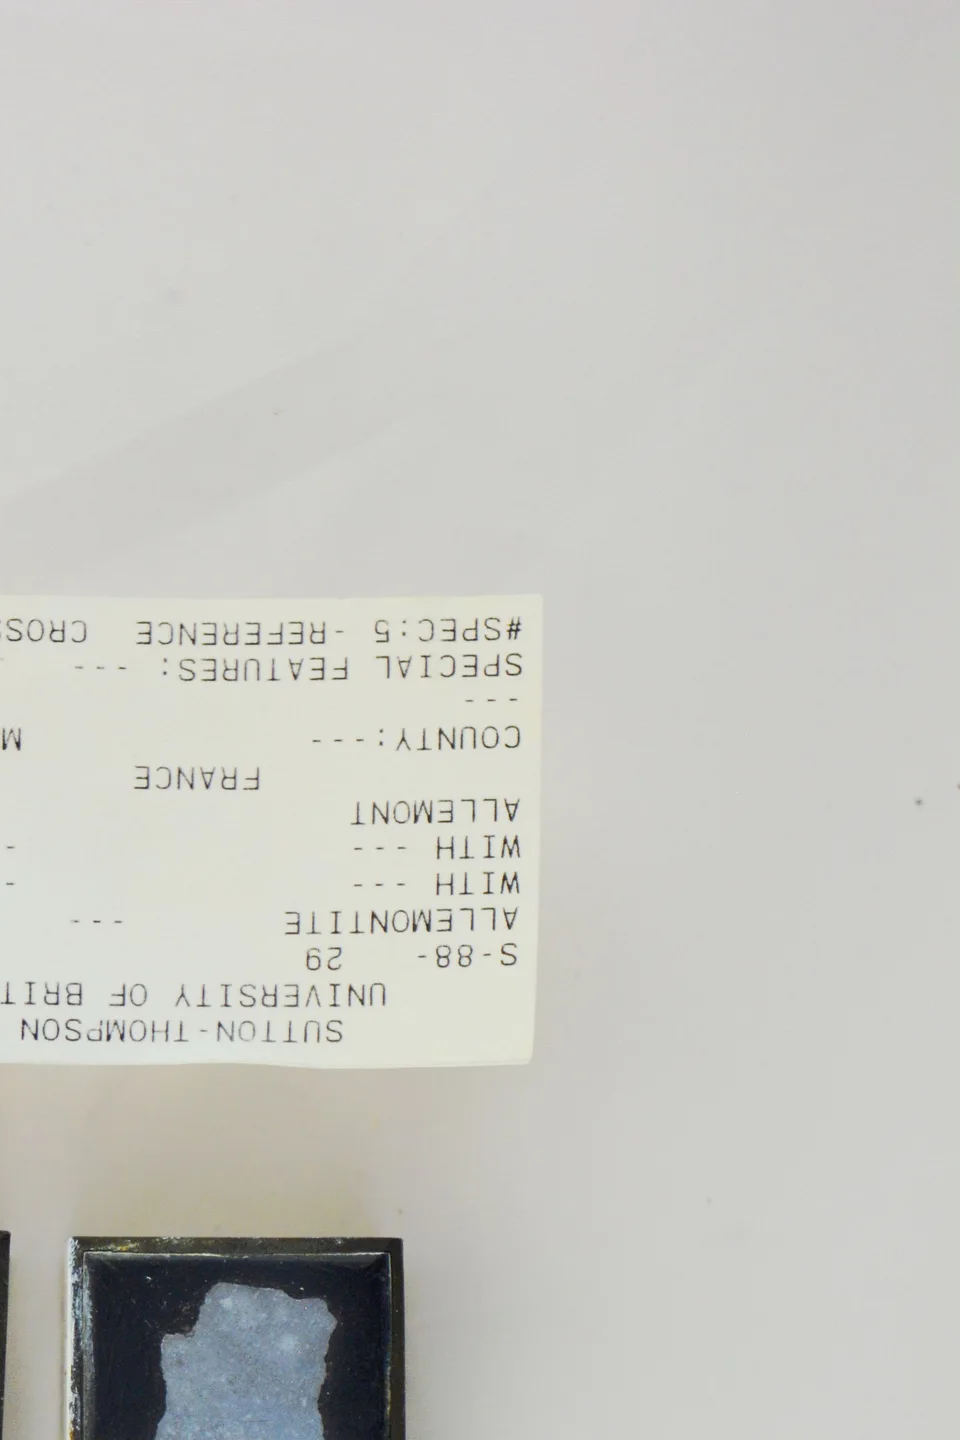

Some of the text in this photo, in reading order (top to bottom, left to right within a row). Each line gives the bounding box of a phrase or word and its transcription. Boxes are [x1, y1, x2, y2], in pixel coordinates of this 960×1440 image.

[162, 656, 349, 683] FEATURES:
[375, 652, 523, 680] SPECIAL
[133, 765, 261, 791] FRANCE
[350, 797, 521, 826] ALLEMONT
[436, 834, 521, 861] WITH
[435, 870, 521, 897] WITH
[284, 906, 519, 936] ALLEMONTITE
[305, 946, 343, 972] 29
[108, 983, 148, 1008] OF
[174, 982, 387, 1009] UNIVERSITY
[20, 1017, 344, 1044] SUTTON-THOMPSON
